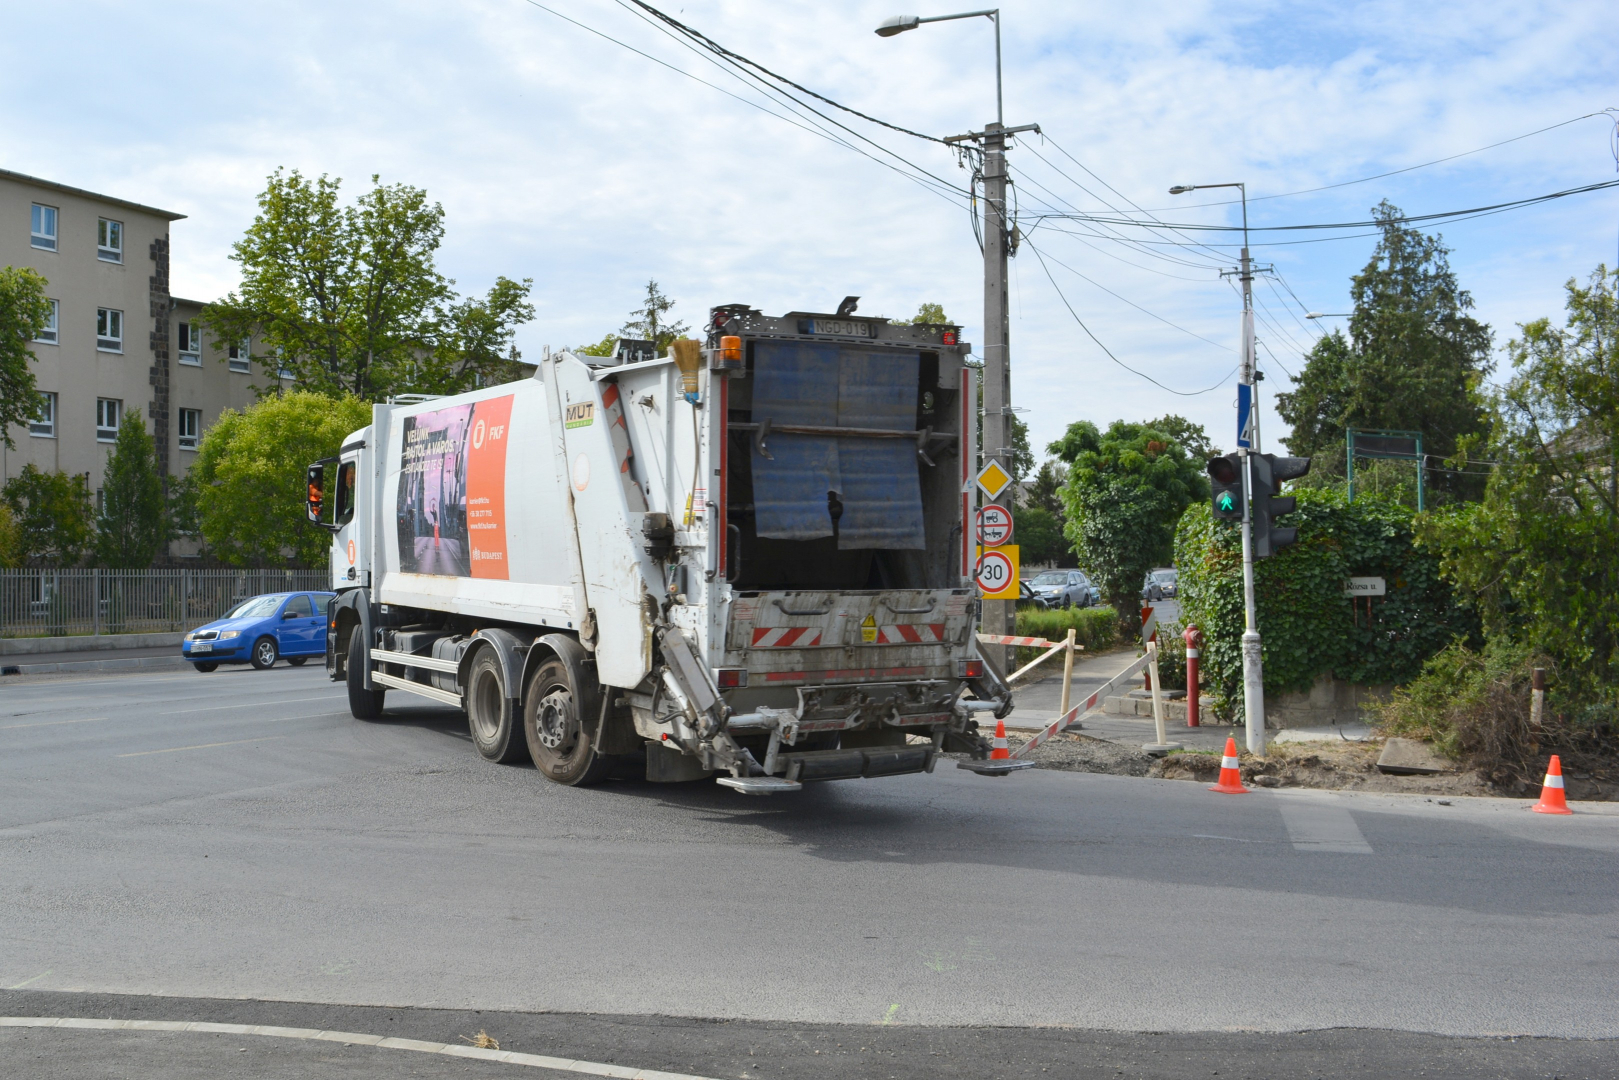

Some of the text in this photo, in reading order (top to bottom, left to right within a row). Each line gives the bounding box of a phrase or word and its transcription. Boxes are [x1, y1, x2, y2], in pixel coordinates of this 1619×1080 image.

[816, 320, 867, 336] NGD-019
[566, 403, 593, 421] MUT
[489, 425, 504, 440] FKF
[426, 443, 432, 456] A
[481, 551, 503, 560] BUDAPEST
[983, 564, 1003, 580] 30
[1347, 582, 1368, 590] Rózsa
